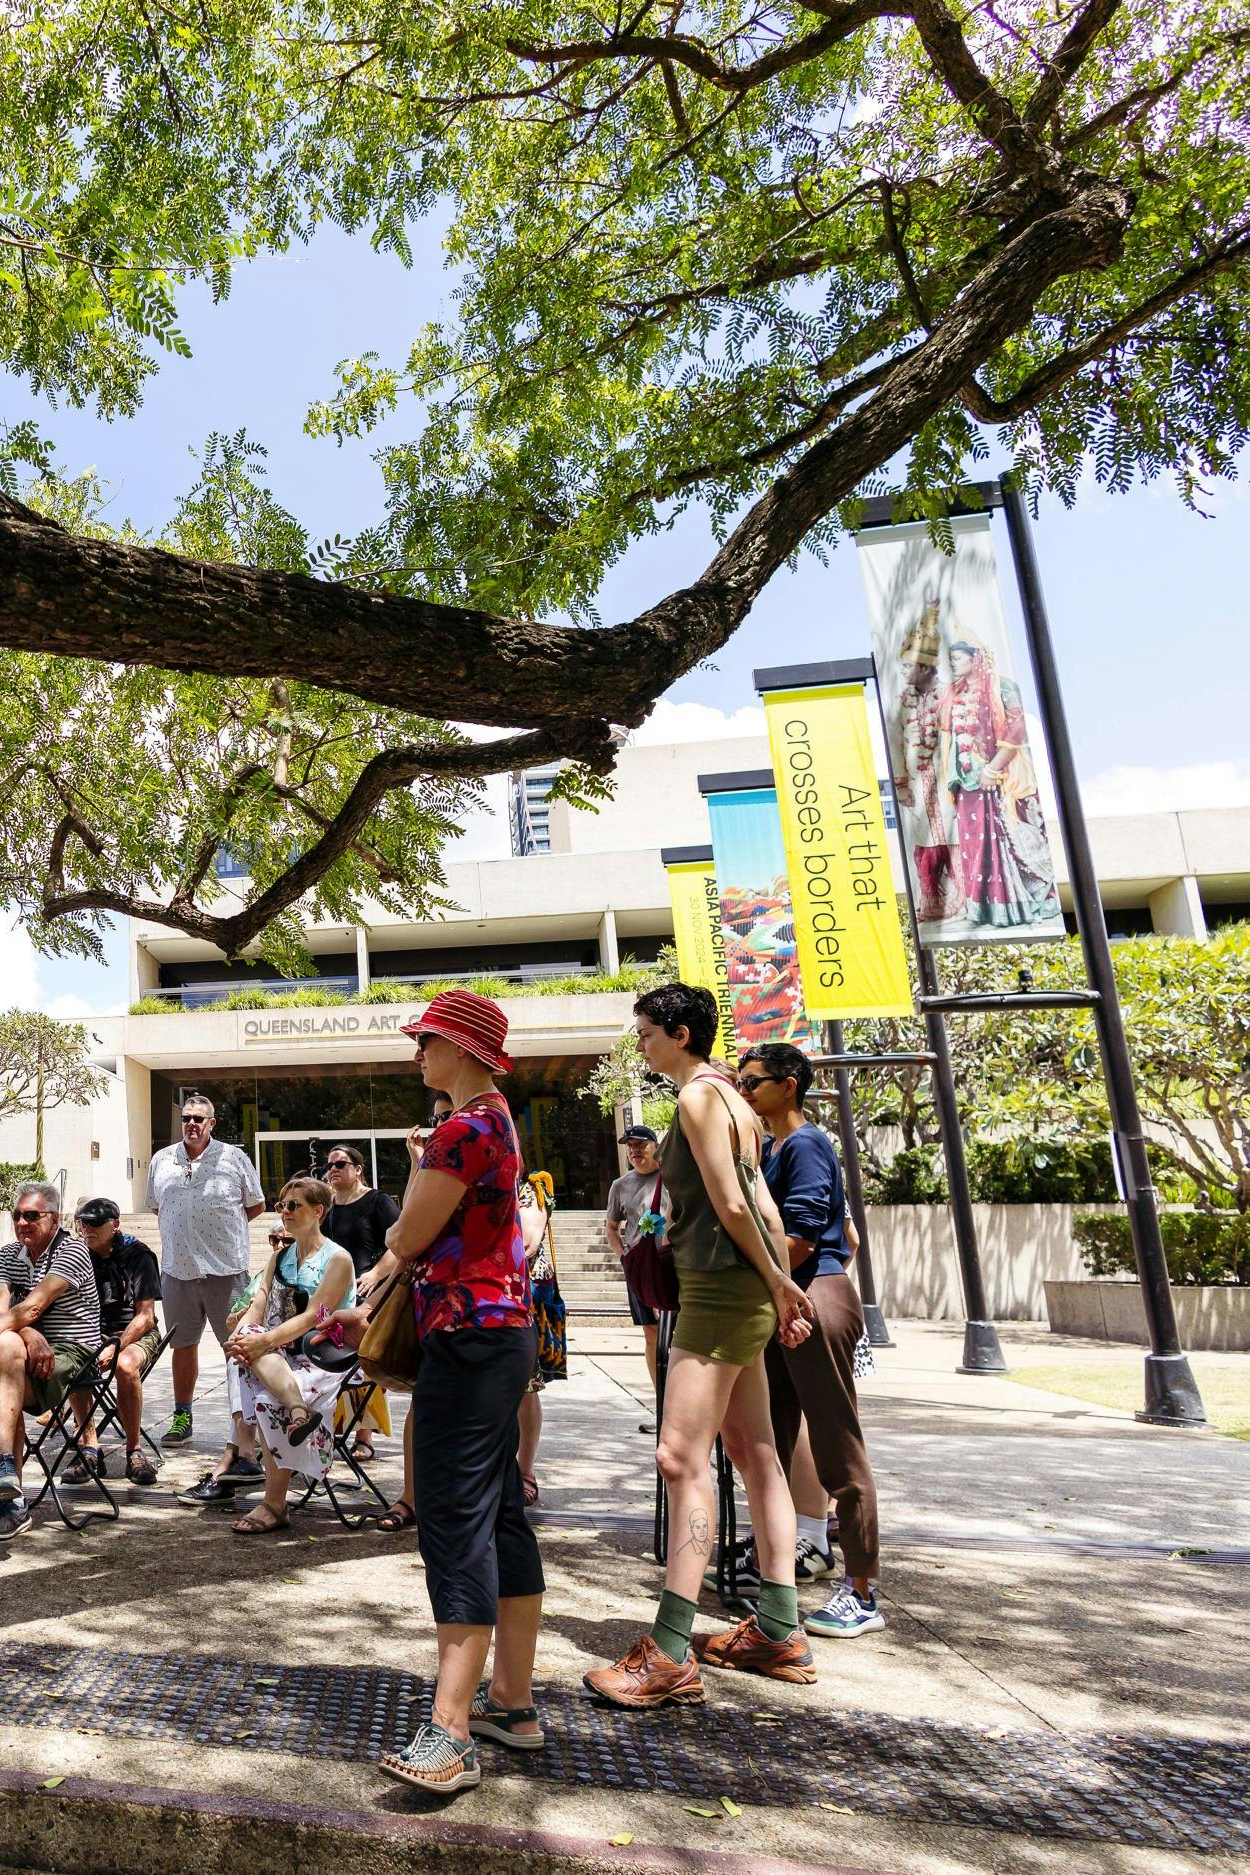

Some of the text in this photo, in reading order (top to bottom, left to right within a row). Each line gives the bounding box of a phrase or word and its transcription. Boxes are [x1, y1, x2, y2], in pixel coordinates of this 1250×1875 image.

[784, 719, 847, 988] crosses borders
[838, 784, 887, 912] Art that
[689, 896, 700, 909] 30
[691, 912, 703, 935] NOV
[694, 937, 706, 963] 2024
[703, 876, 738, 1061] ASIA PACIFIC TRIENNIAL
[244, 1016, 360, 1037] QUEENSLAND
[367, 1015, 401, 1032] ART
